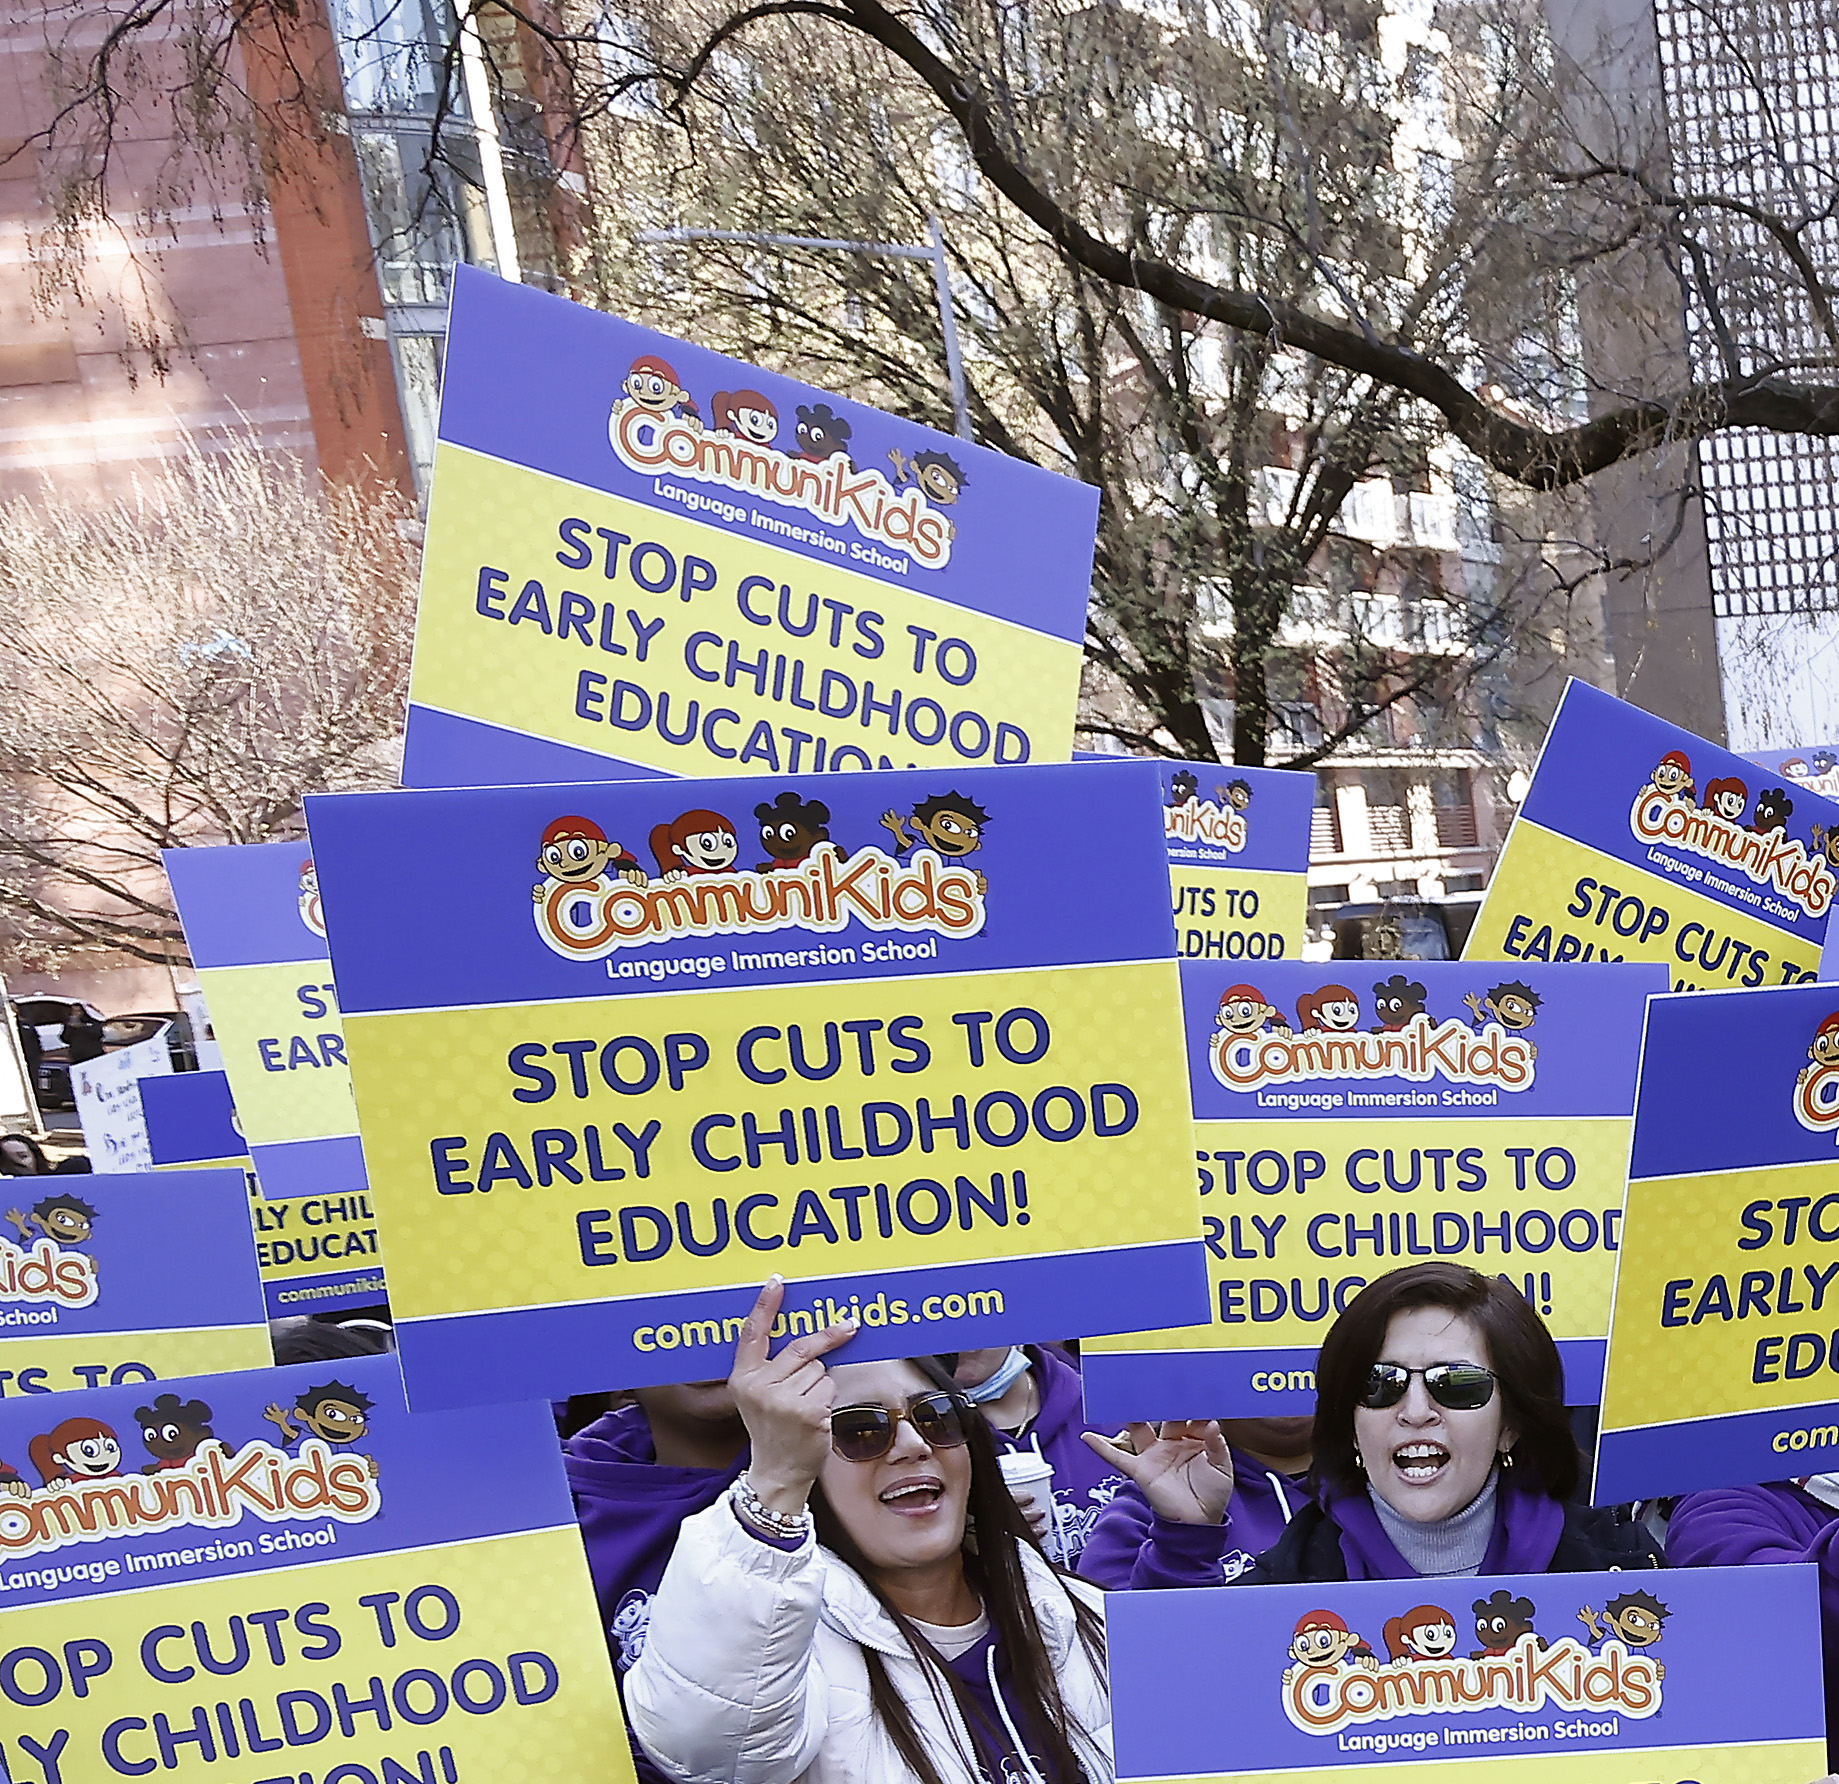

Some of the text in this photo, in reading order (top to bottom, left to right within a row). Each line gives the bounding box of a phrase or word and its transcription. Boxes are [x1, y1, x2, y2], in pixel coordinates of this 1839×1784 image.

[617, 402, 946, 562] CommuniKids
[654, 477, 908, 575] Language Immersion School
[556, 517, 978, 686] STOP CUTS TO
[476, 566, 1032, 770] EARLY CHILDHOOD
[545, 850, 976, 950] CommuniKids
[1567, 877, 1769, 988] STOP CUTS
[606, 937, 937, 981] Language Immersion School
[509, 1008, 1050, 1103] STOP CUTS TO
[1217, 1019, 1529, 1086] CommuniKids
[1257, 1089, 1497, 1110] Language Immersion School
[431, 1084, 1139, 1195] EARLY CHILDHOOD
[1345, 1147, 1576, 1193] CUTS TO
[576, 1171, 1030, 1266] EDUCATION!
[124, 1524, 336, 1572] Immersion School
[141, 1585, 461, 1684] CUTS TO
[102, 1651, 559, 1776] CHILDHOOD
[1291, 1640, 1655, 1727] CommuniKids
[1338, 1717, 1619, 1754] Language Immersion School
